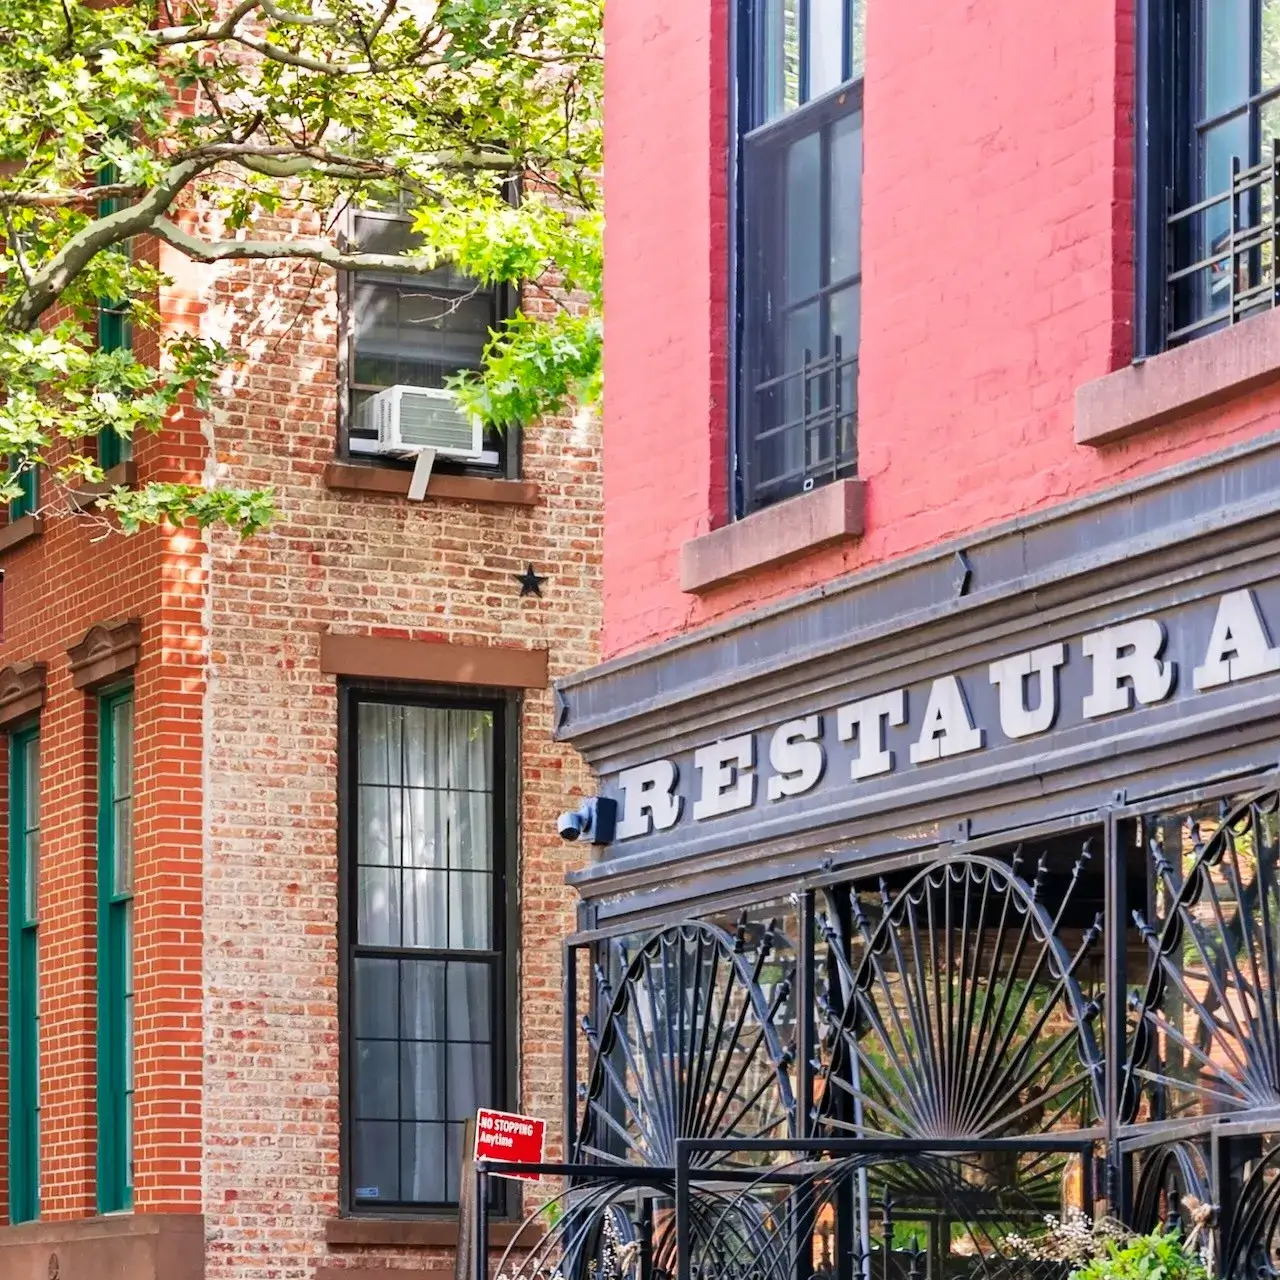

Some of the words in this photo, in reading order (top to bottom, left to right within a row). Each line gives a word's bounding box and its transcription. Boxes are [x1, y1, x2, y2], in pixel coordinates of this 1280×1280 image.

[480, 1117, 492, 1129] NO
[494, 1119, 533, 1136] STOPPING
[480, 1131, 513, 1147] Anytime
